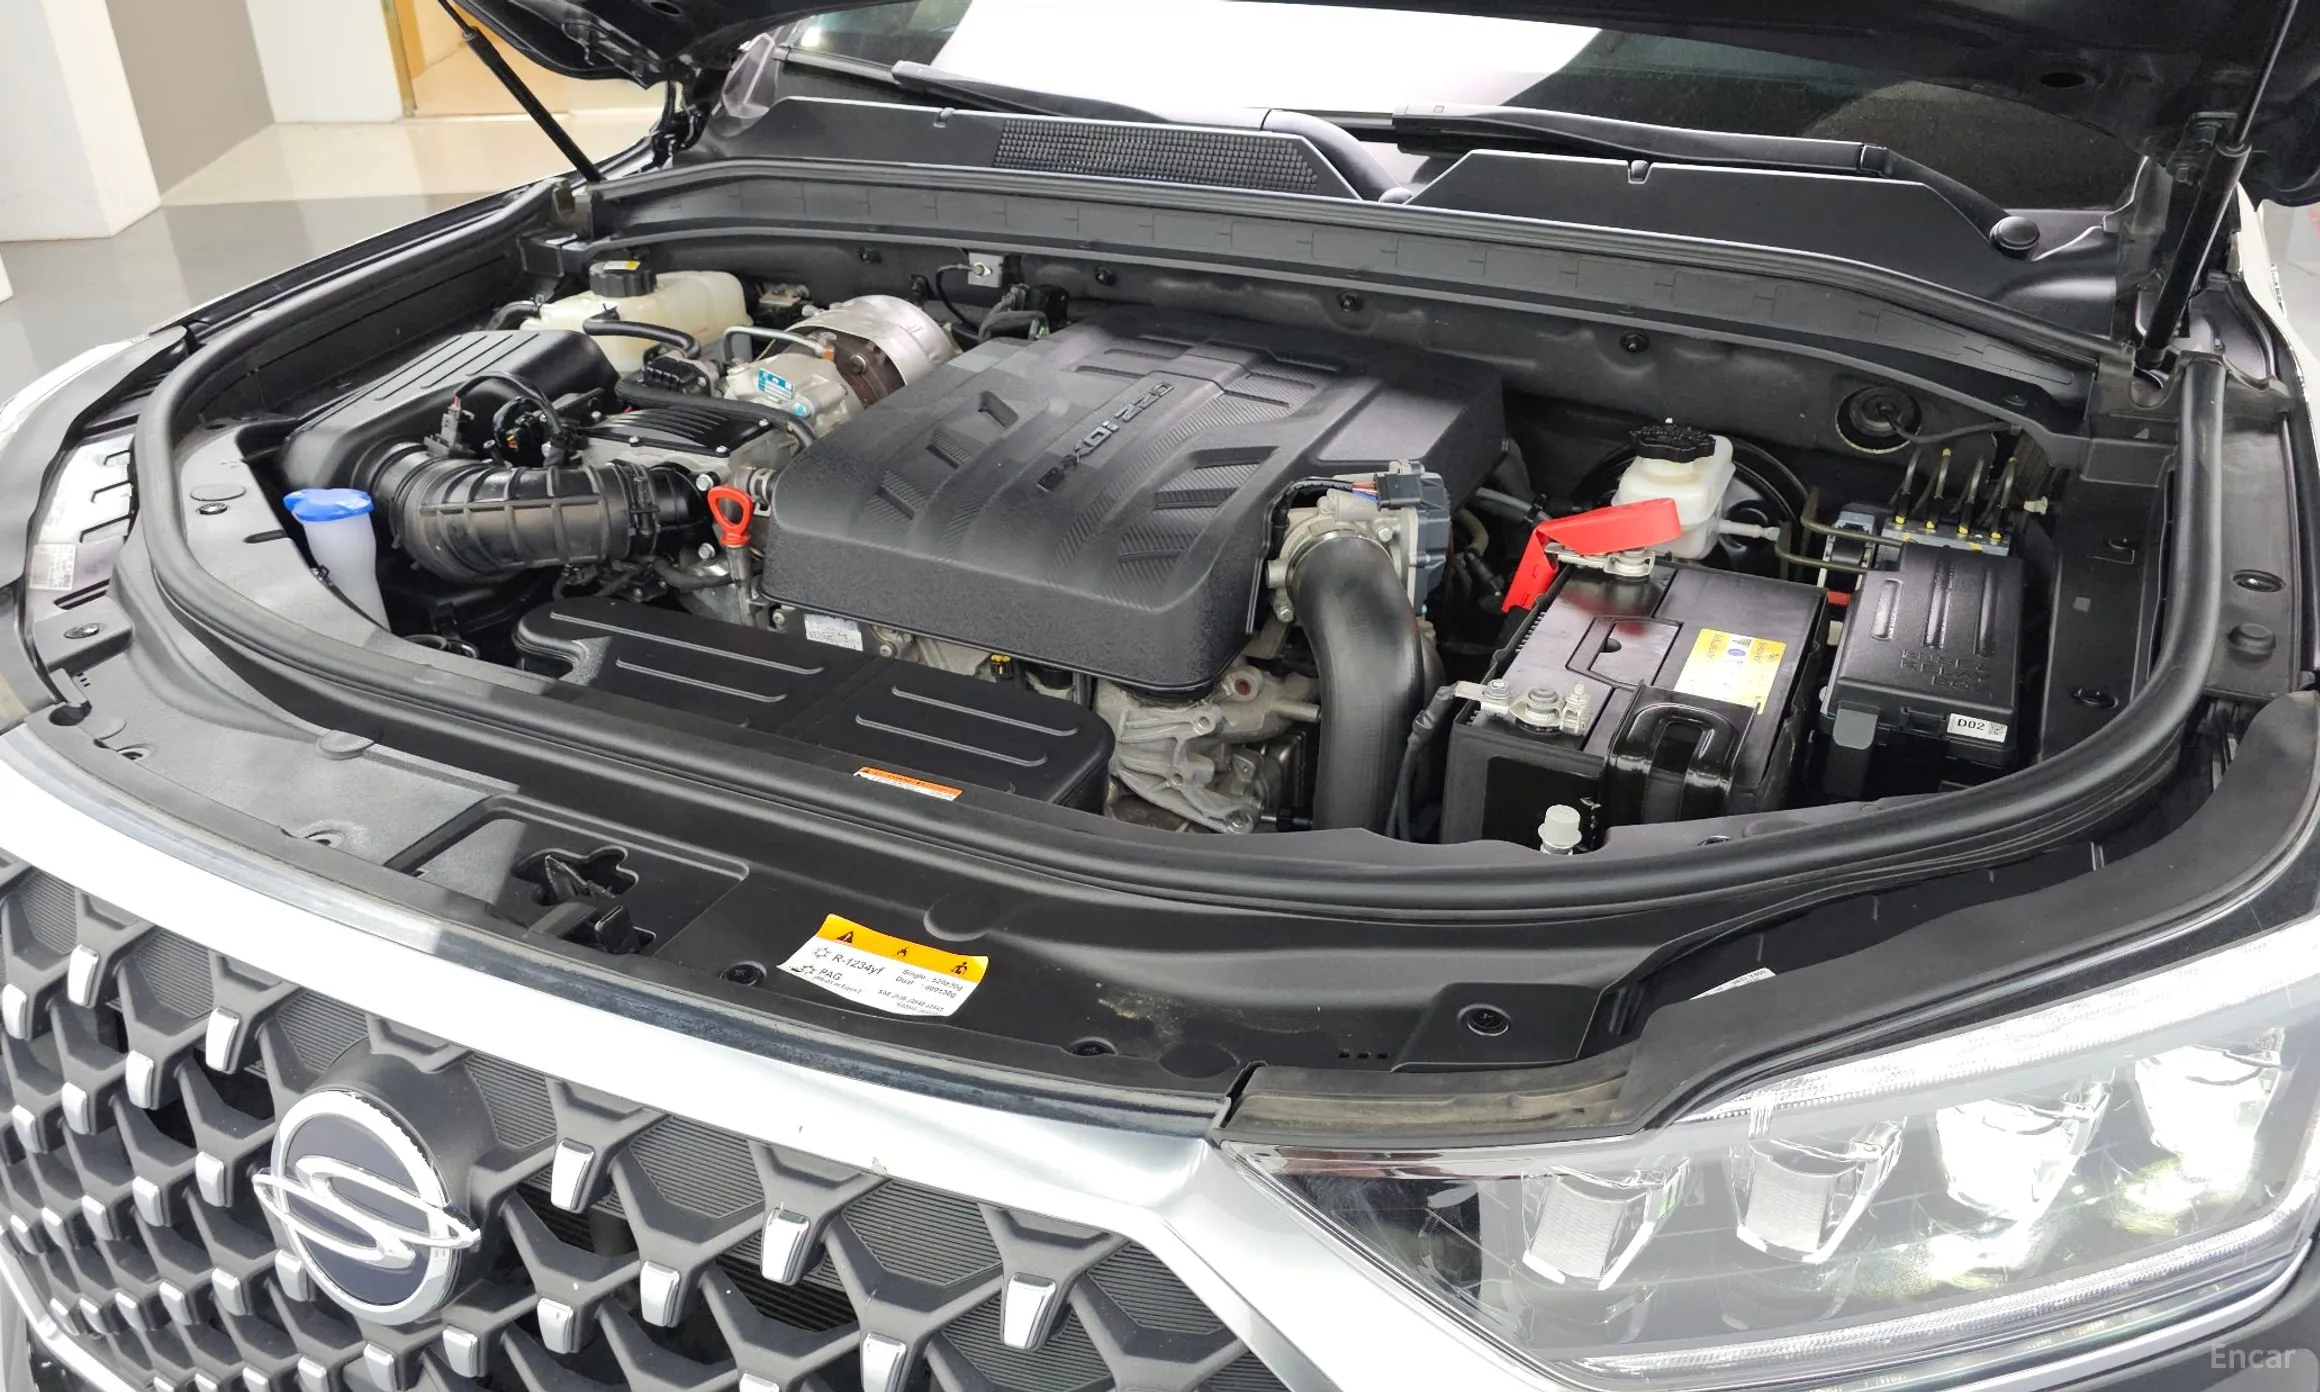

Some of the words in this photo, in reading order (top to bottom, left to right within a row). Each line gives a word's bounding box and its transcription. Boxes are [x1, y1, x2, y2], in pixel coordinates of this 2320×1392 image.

[1114, 380, 1175, 424] 220
[1957, 718, 1986, 731] D02
[832, 953, 886, 975] R-1234yf
[819, 967, 843, 981] PAG
[895, 975, 914, 985] Dual
[902, 968, 926, 980] Single
